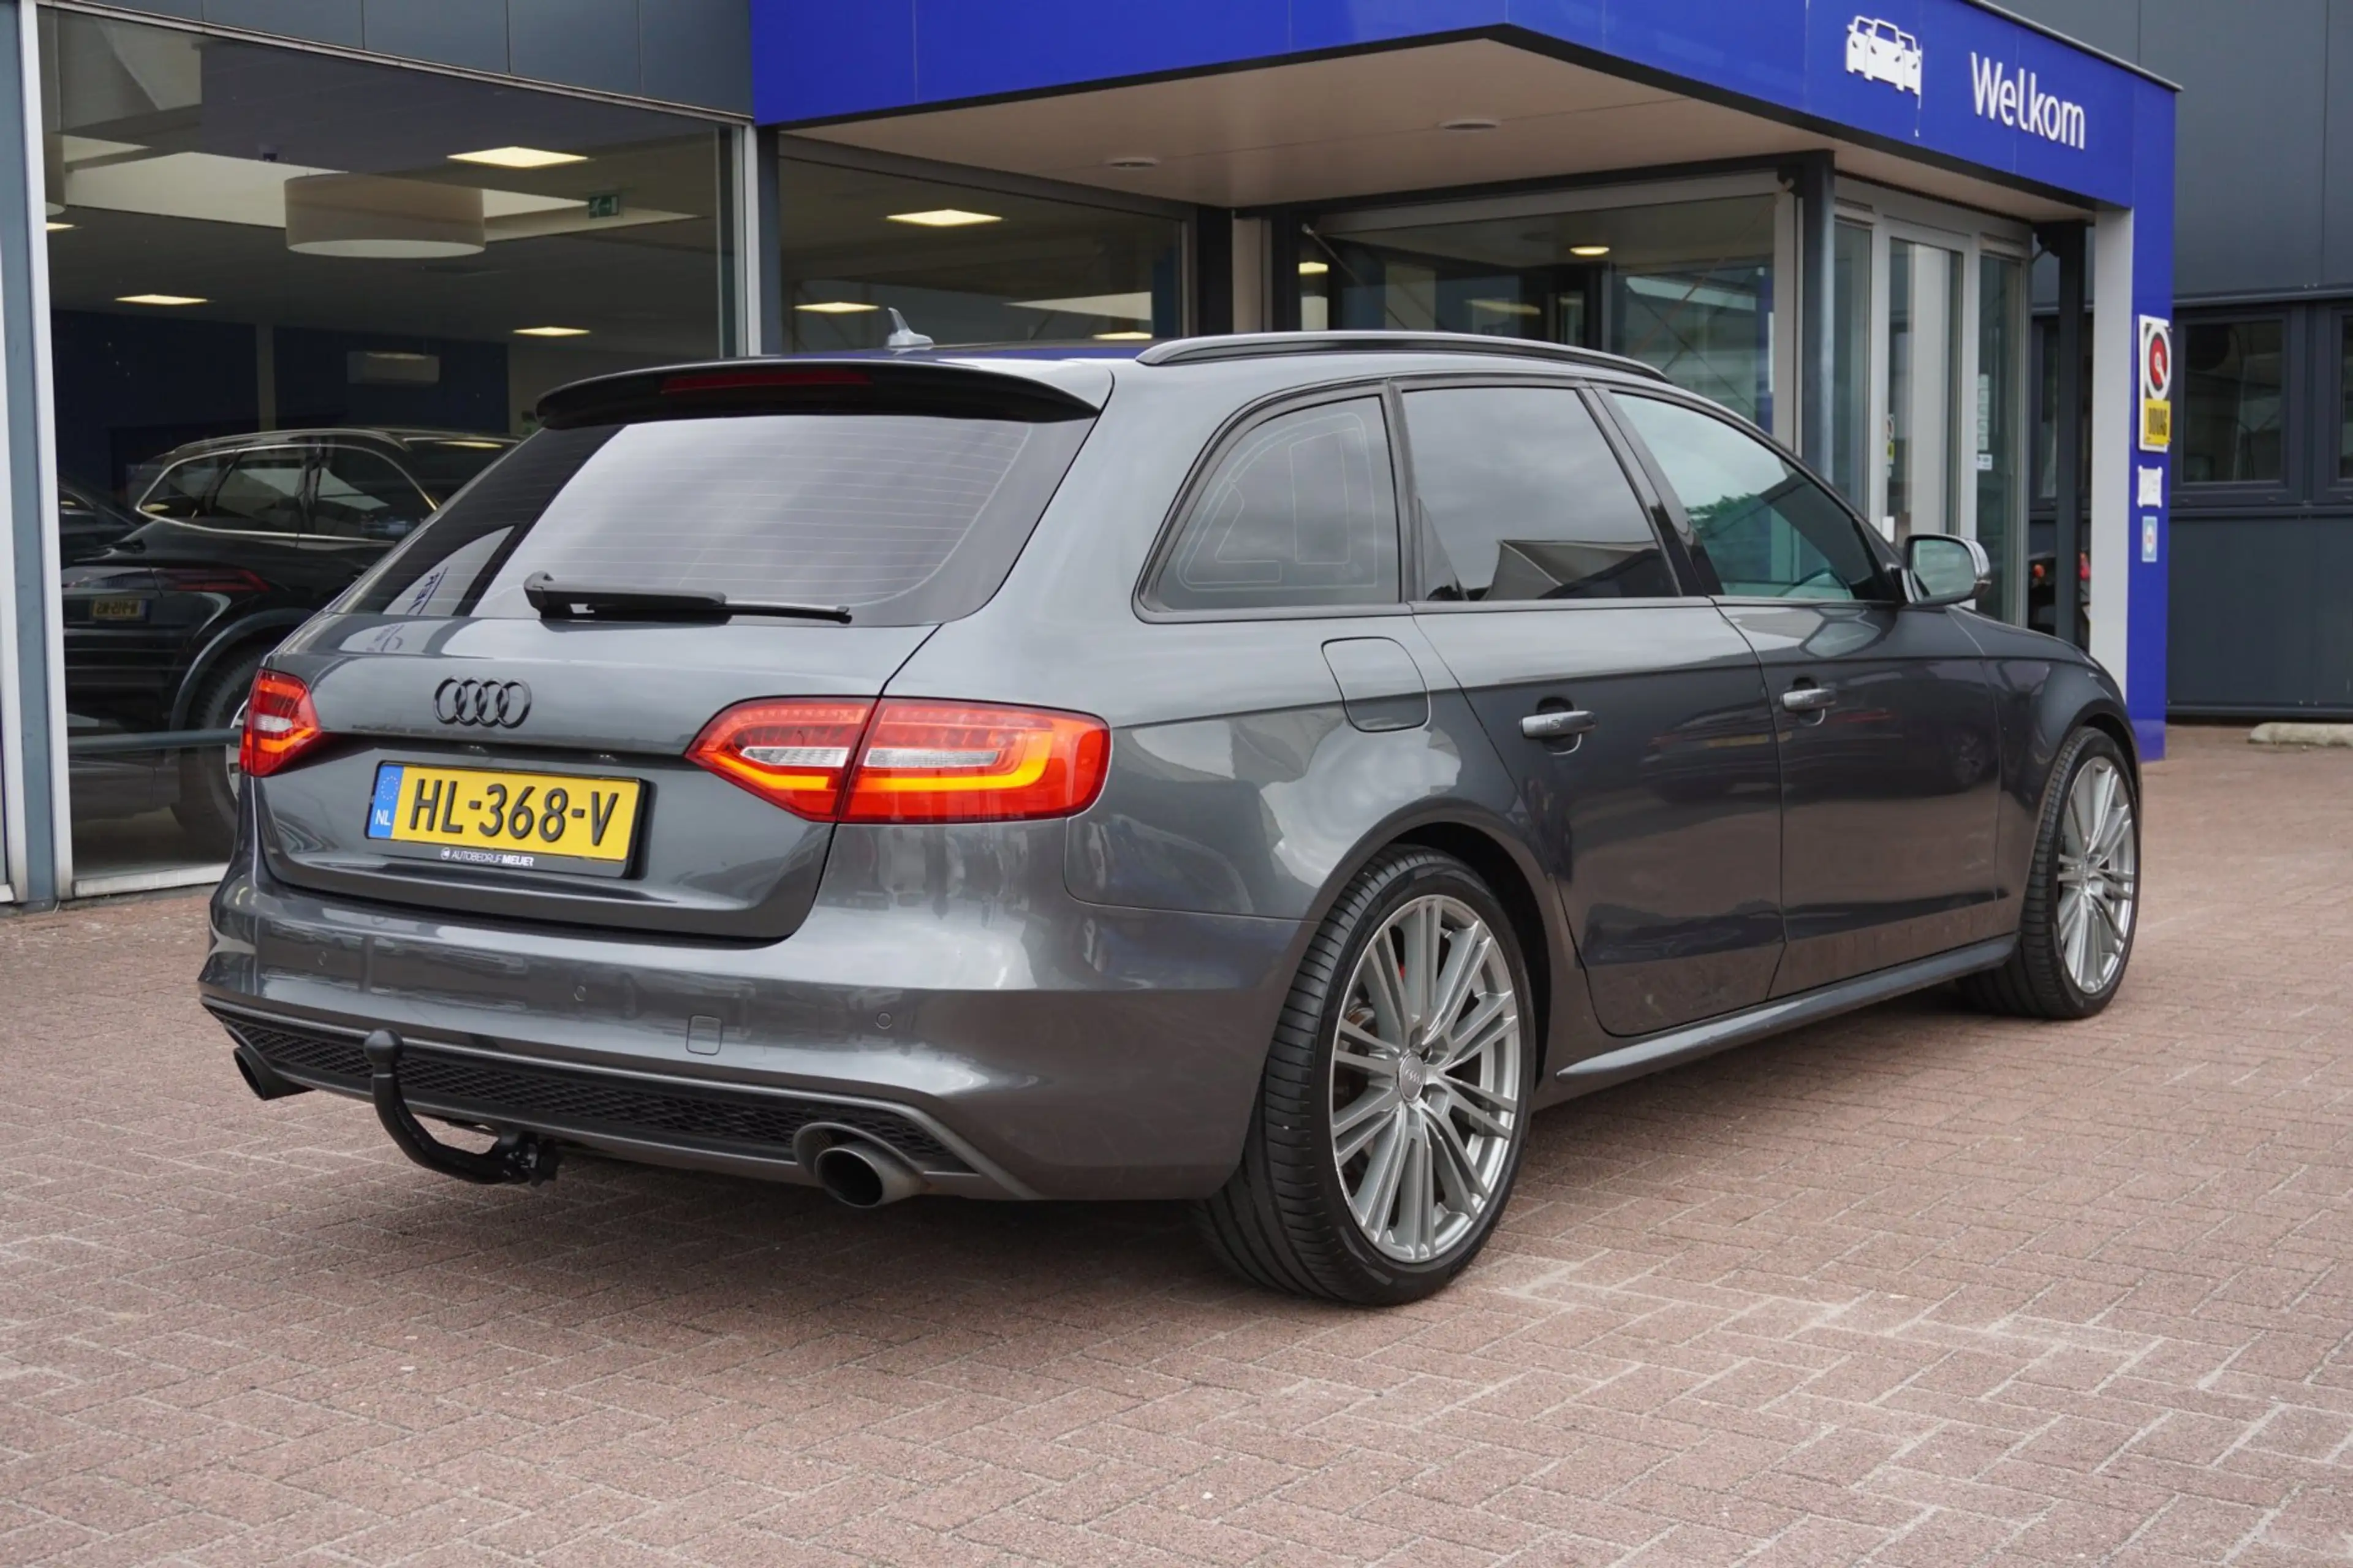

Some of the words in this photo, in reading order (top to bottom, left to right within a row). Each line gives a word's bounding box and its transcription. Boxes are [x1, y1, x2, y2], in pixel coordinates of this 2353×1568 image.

[1971, 51, 2085, 150] Welkom
[375, 809, 391, 826] NL
[409, 778, 619, 846] HL-368-V
